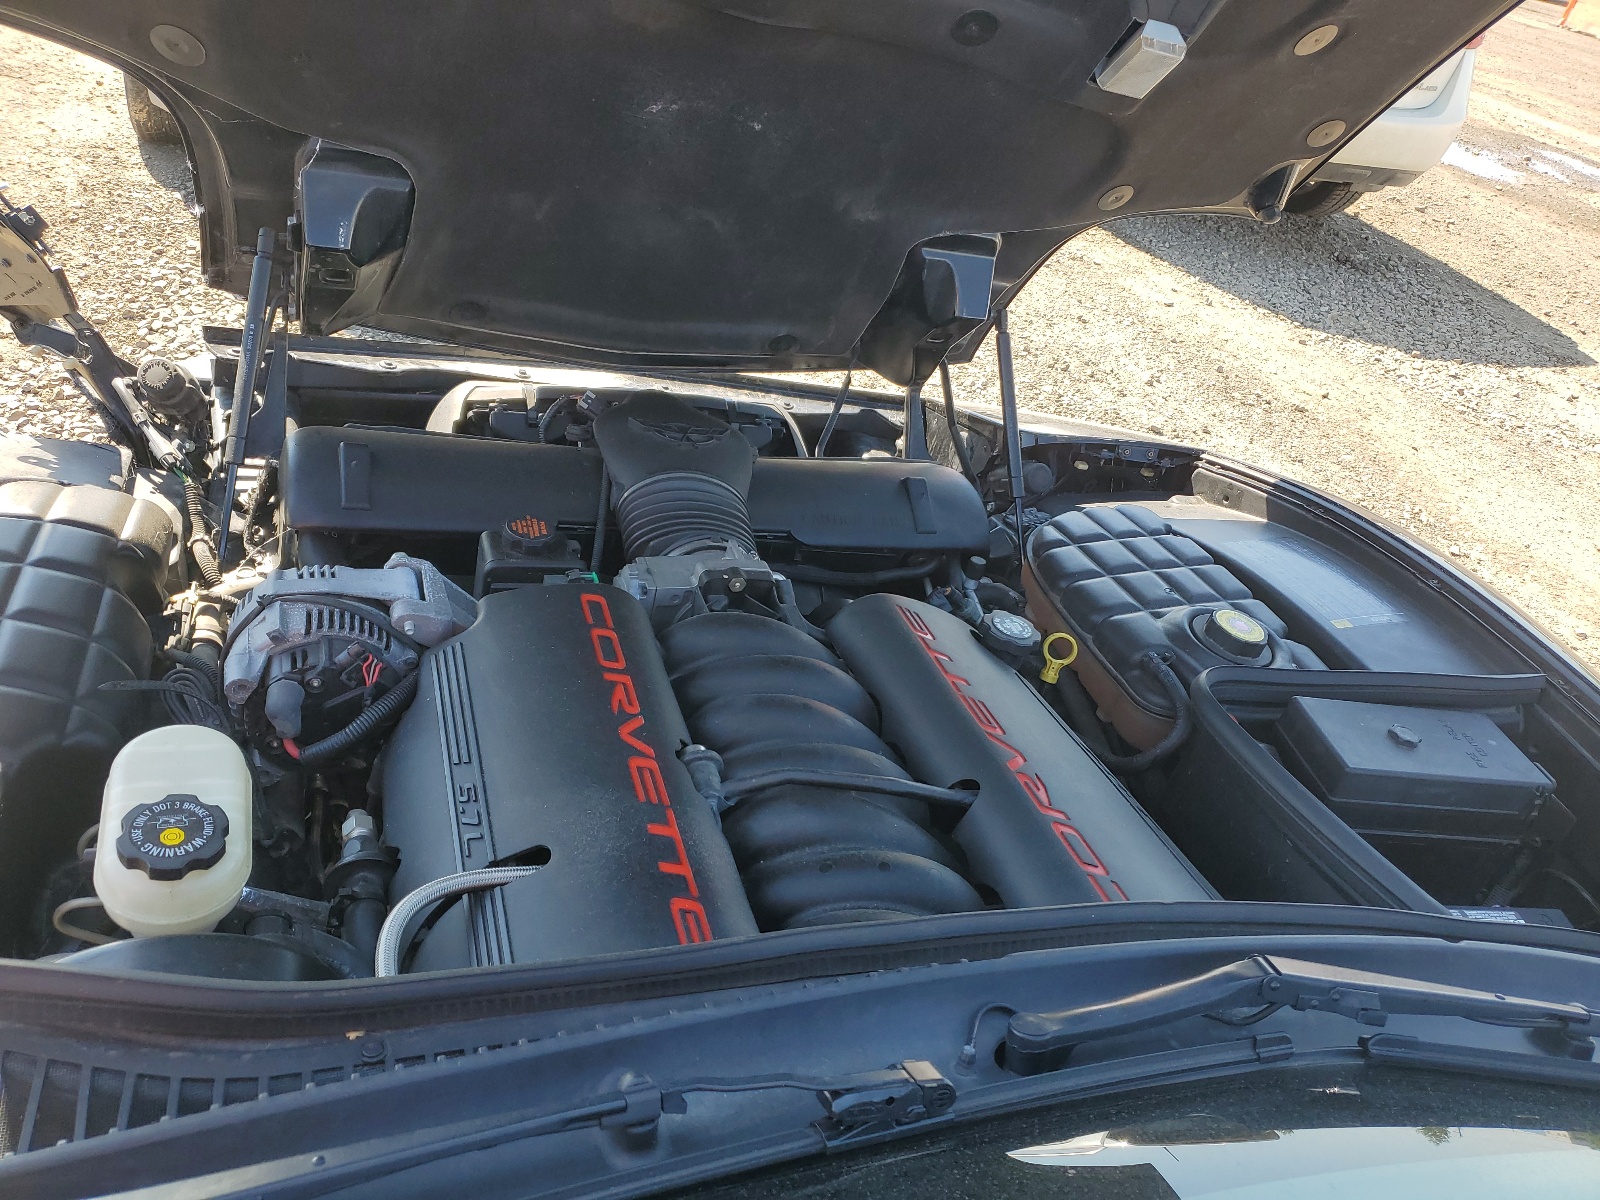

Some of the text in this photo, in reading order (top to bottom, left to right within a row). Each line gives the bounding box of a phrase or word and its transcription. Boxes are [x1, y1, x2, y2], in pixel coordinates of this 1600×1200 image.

[580, 593, 713, 945] CORVETTE
[152, 801, 172, 814] DOT
[174, 801, 180, 809] 3
[182, 801, 210, 818] BRAKE
[133, 809, 153, 828] ONLY
[202, 815, 215, 836] FLUID
[457, 782, 483, 858] 5.7L
[131, 828, 144, 842] USE
[140, 837, 207, 858] WARNING
